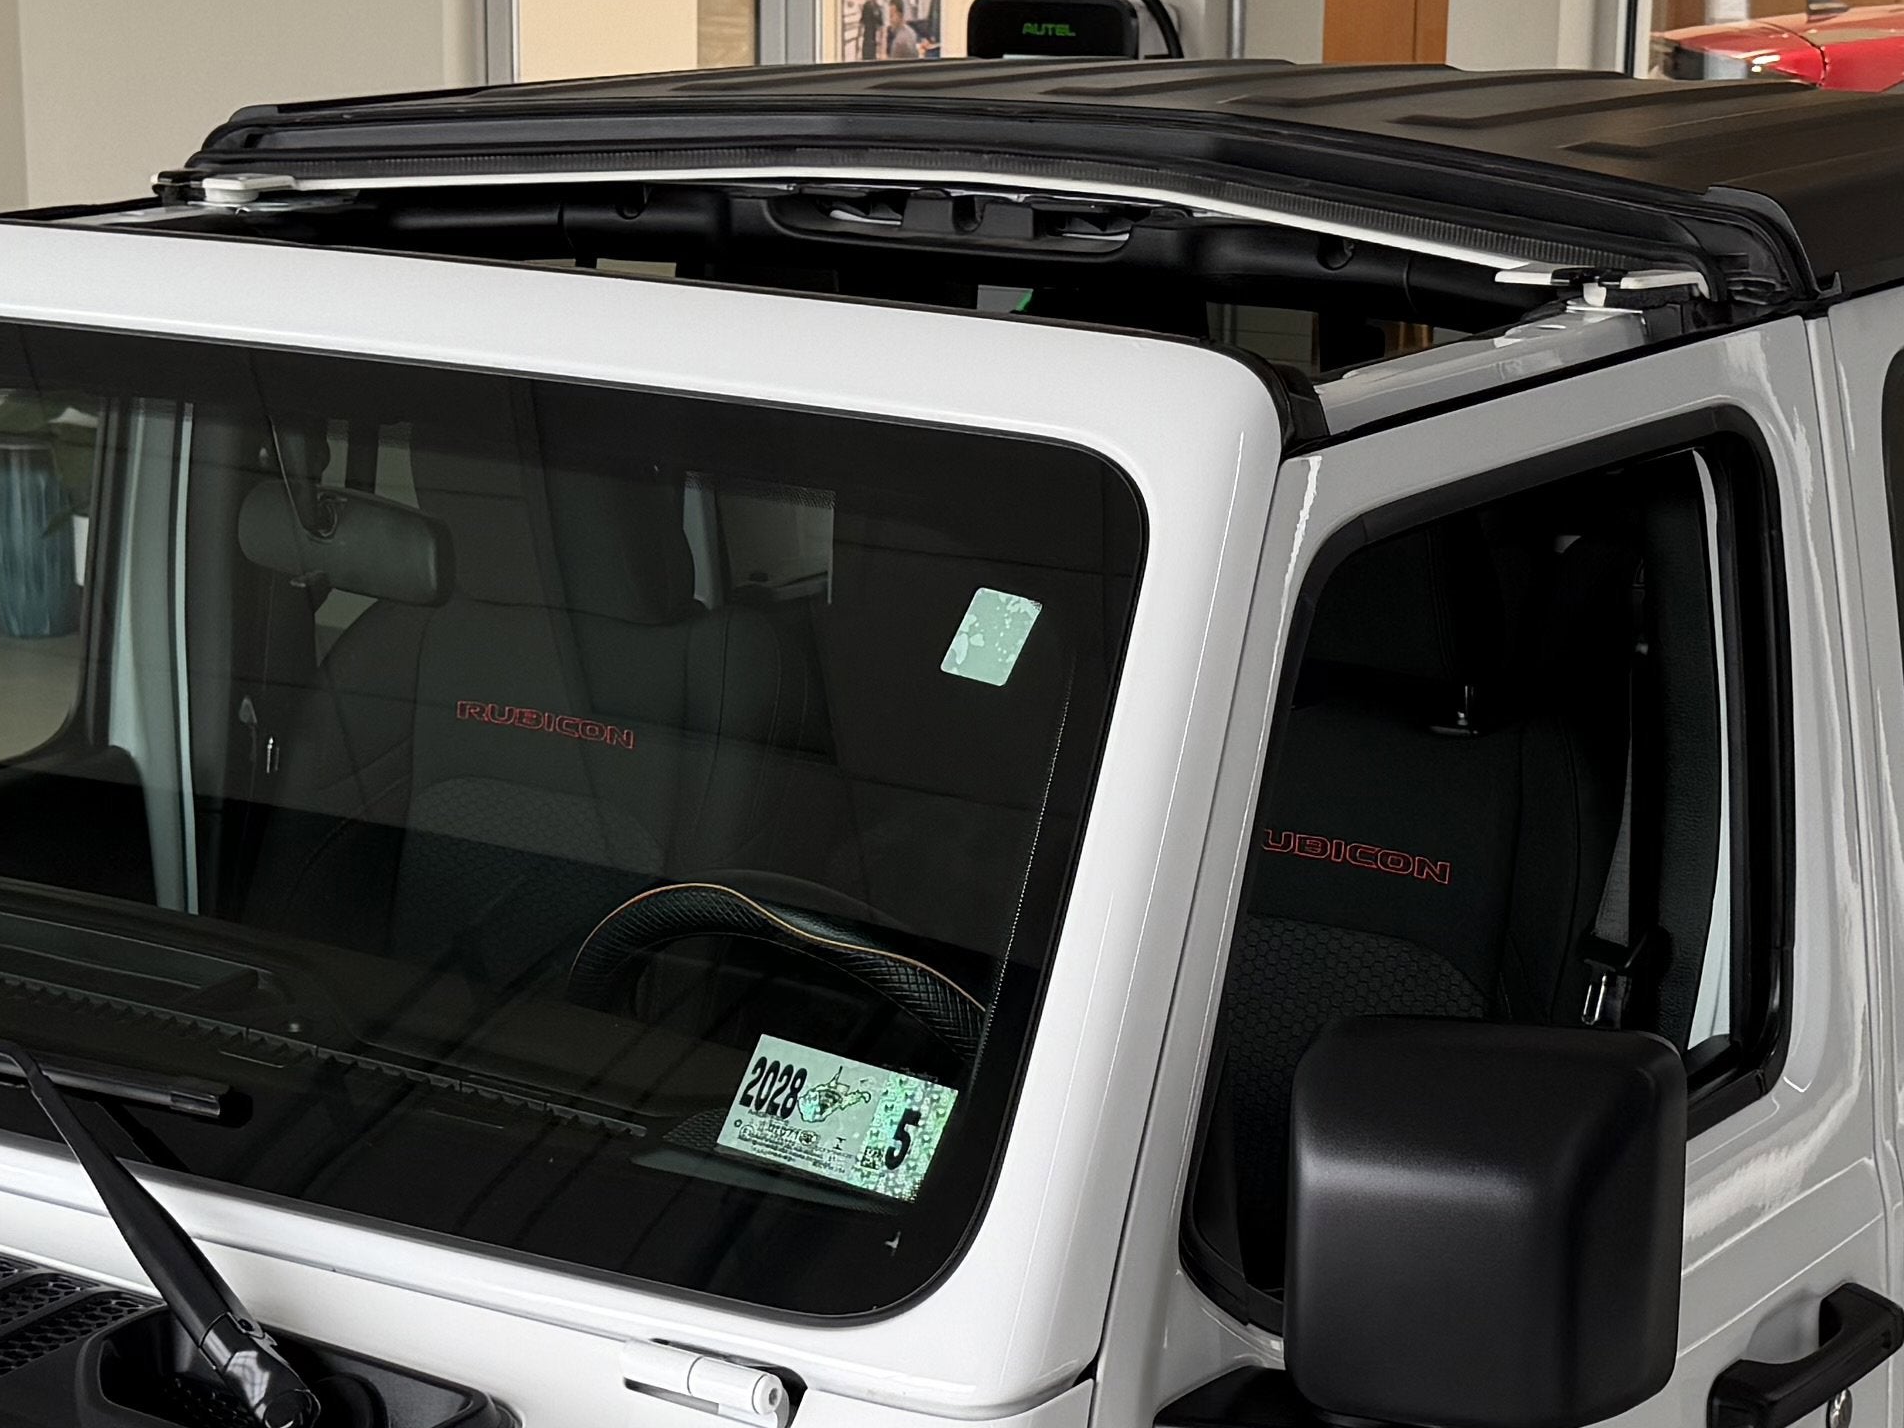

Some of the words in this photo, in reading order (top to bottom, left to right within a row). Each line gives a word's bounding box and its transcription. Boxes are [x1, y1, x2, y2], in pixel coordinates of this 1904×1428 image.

[1022, 22, 1076, 37] AUTEL
[456, 700, 637, 750] RUBICON
[1261, 828, 1451, 885] UBICON
[739, 1056, 808, 1120] 2028
[885, 1108, 922, 1170] 5
